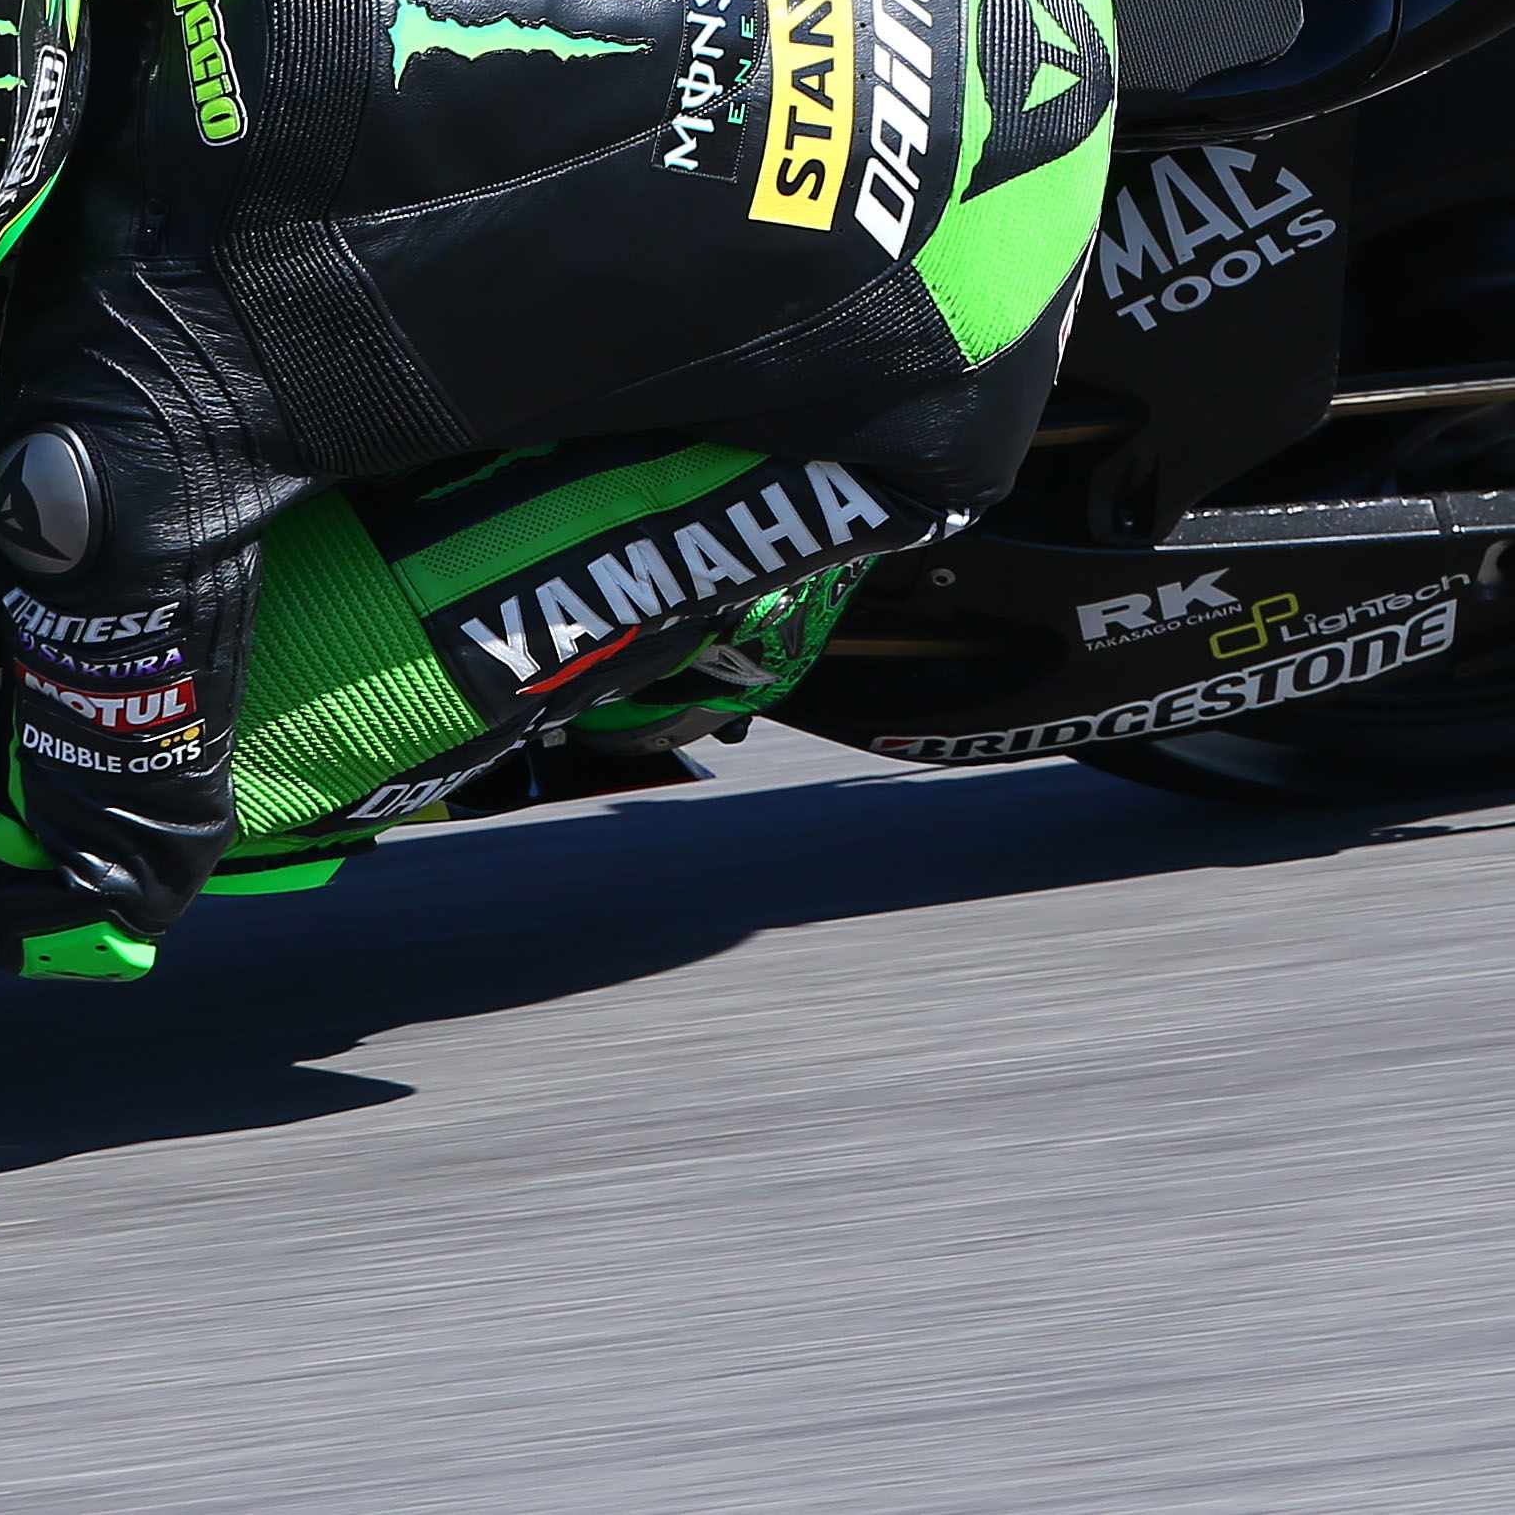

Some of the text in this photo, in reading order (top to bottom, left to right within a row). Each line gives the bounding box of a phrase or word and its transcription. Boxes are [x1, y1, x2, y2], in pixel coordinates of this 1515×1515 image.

[1115, 208, 1337, 331] TOOLS
[461, 459, 890, 683] YAMAHA
[1076, 567, 1240, 642] RK
[1084, 602, 1242, 652] TAKASAGO CHAIN
[39, 642, 187, 679] SAKURA
[871, 598, 1458, 761] BRIDGESTONE
[24, 672, 188, 727] MOTUL
[23, 723, 122, 774] DRIBBLE
